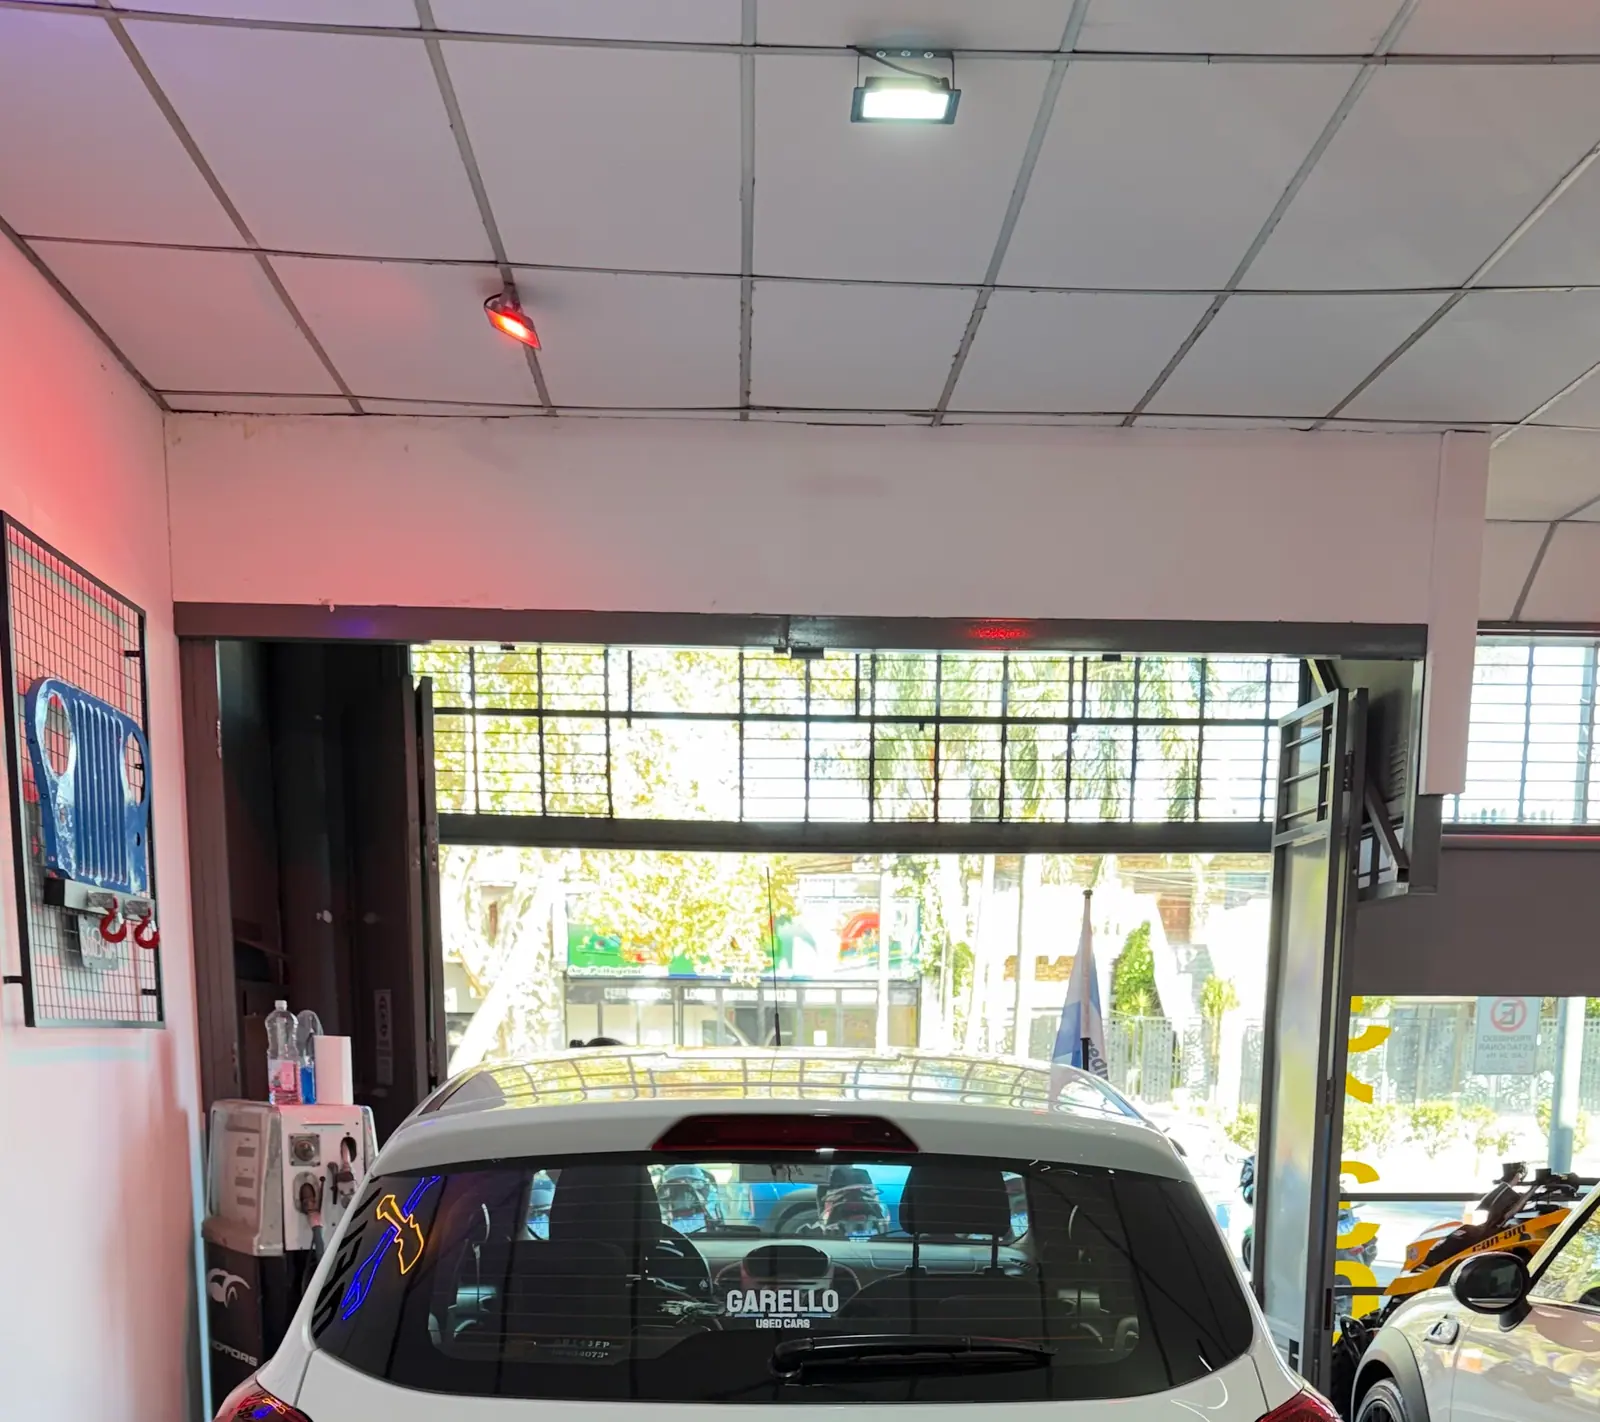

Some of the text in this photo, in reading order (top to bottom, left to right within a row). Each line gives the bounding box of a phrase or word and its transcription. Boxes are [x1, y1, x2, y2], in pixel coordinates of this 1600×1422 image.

[726, 1289, 839, 1313] GARELLO
[756, 1318, 811, 1329] USED CARS
